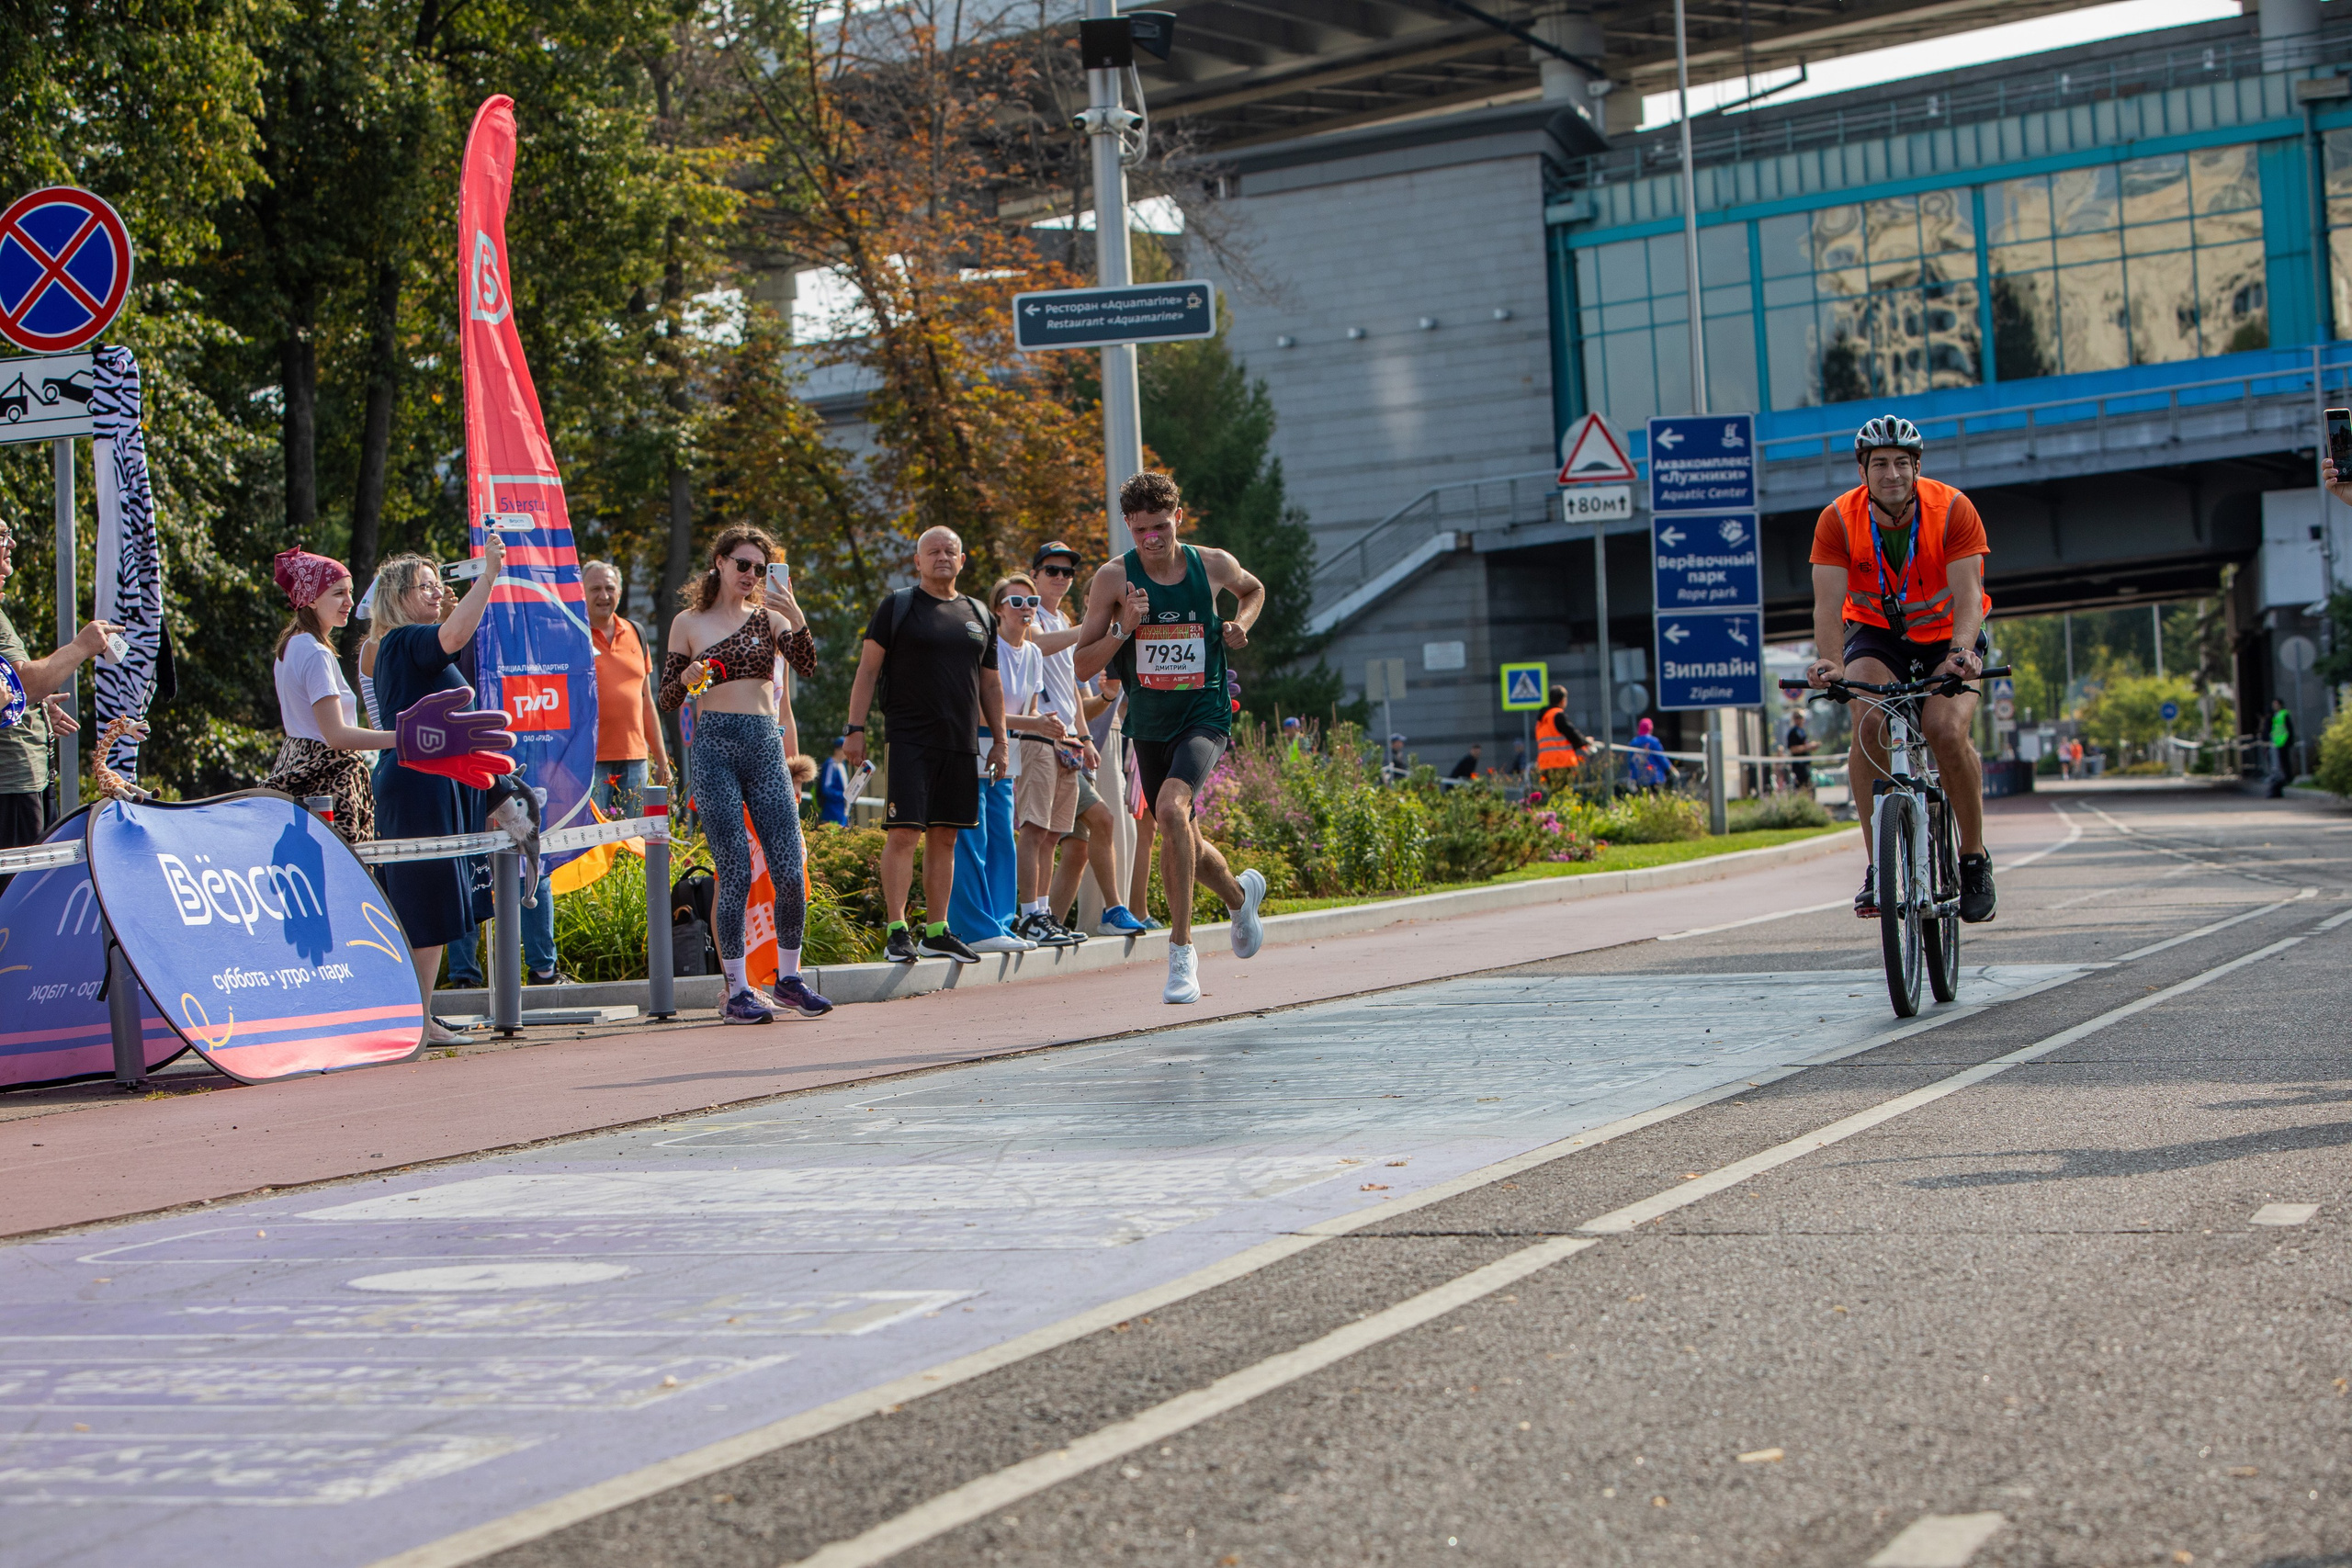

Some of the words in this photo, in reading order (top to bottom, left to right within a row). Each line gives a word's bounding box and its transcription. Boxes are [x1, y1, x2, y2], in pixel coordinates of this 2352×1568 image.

[1046, 301, 1098, 314] Ресторан
[1101, 296, 1182, 311] «Aquamarine»
[1046, 316, 1104, 329] Restaurant
[1107, 311, 1184, 325] «Aquamarine»
[1655, 457, 1751, 471] Аквакомплекс
[1659, 469, 1747, 486] «Лужники»
[1661, 489, 1705, 502] Aquatic
[1708, 488, 1747, 500] Center
[501, 497, 550, 512] 5verst.r
[1578, 496, 1616, 513] 80м
[1657, 551, 1756, 571] Верёвочный
[1687, 571, 1726, 586] парк
[1678, 588, 1708, 602] Rope
[1709, 586, 1737, 602] park
[1146, 644, 1195, 663] 7934
[543, 663, 569, 671] ПАРТНЕР
[1663, 657, 1756, 680] Зиплайн
[1689, 686, 1734, 701] Zipline
[536, 734, 554, 742] «РЖД»
[212, 965, 270, 994] суббота
[276, 966, 311, 989] утро
[317, 963, 355, 984] парк
